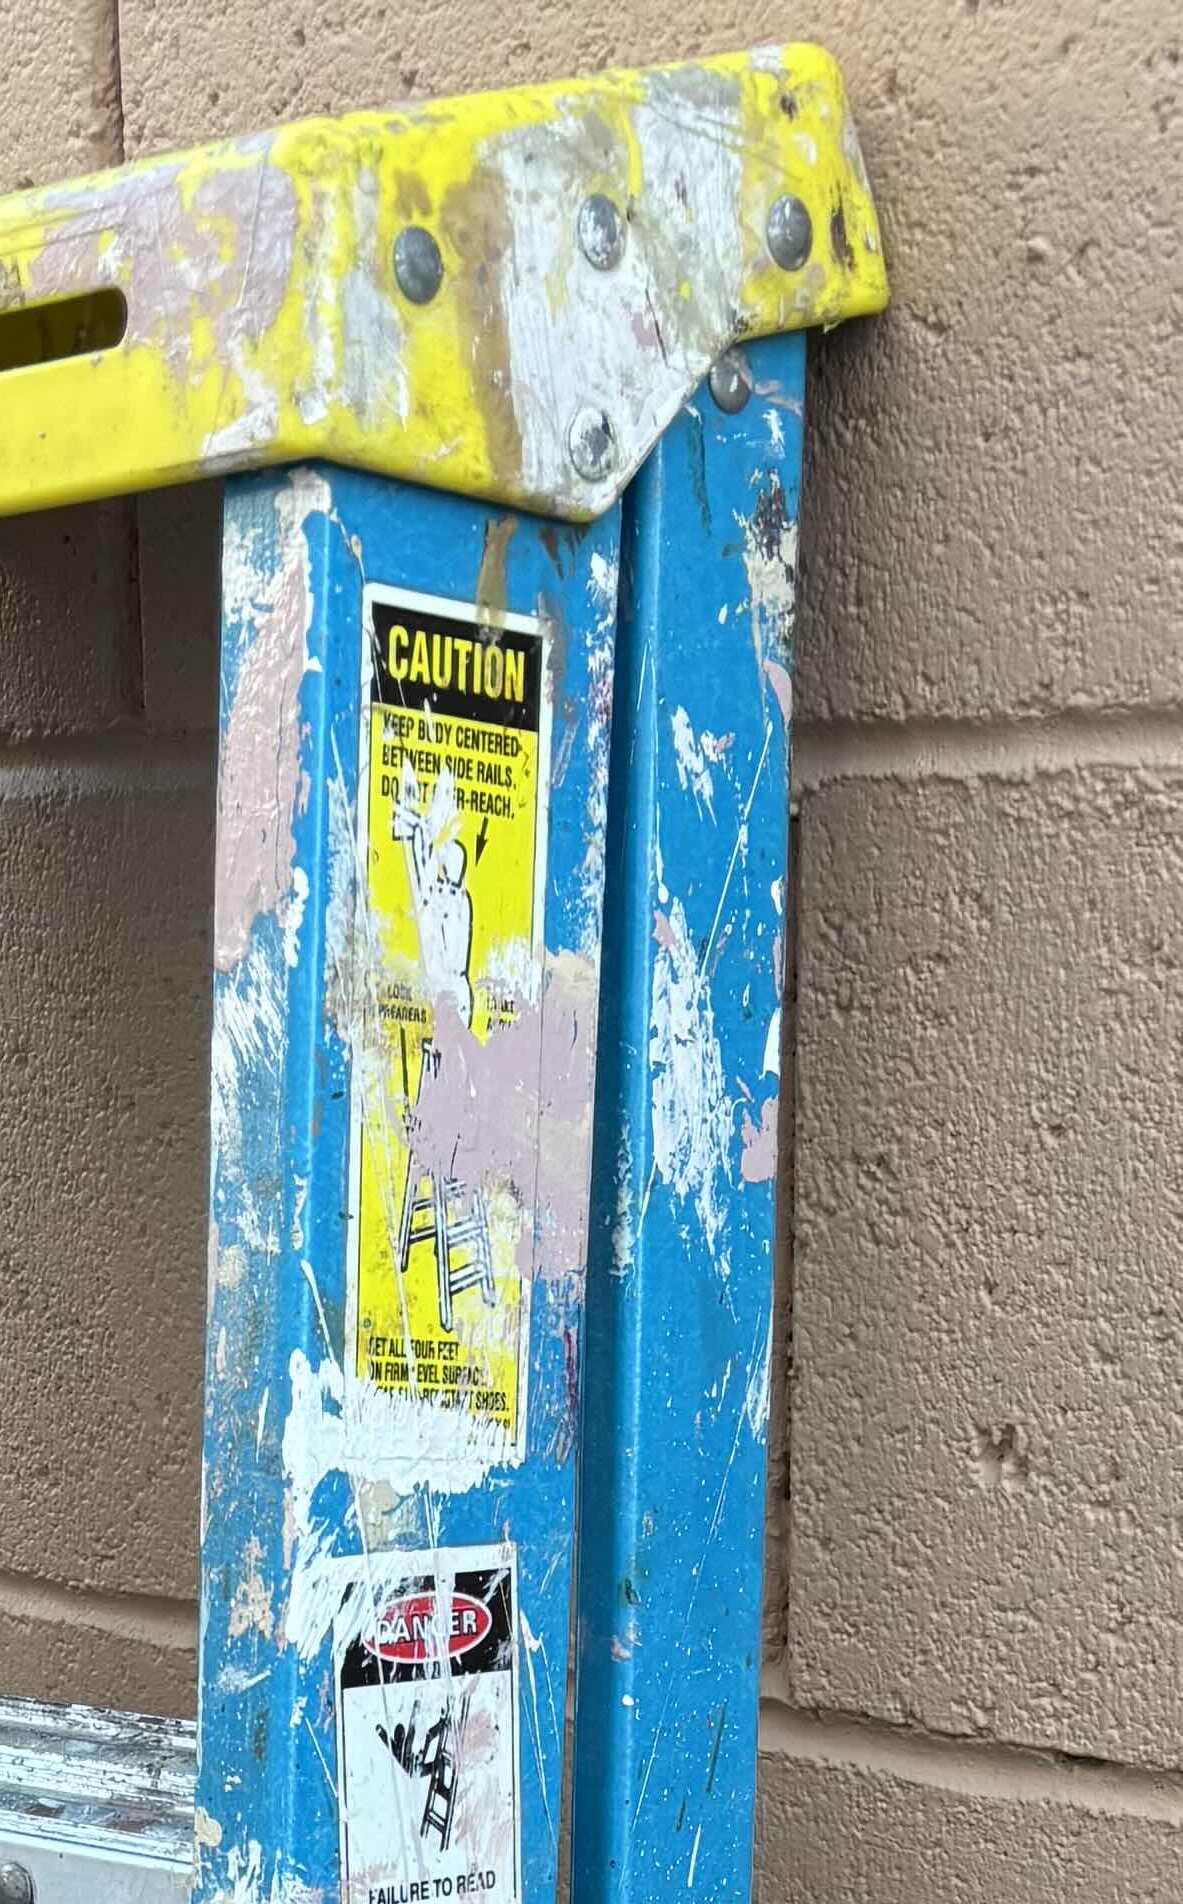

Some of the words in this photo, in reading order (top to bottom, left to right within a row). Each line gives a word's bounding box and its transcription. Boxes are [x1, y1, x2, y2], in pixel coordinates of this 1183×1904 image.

[388, 624, 526, 703] CAUTION
[455, 726, 519, 758] CENTERED
[476, 760, 517, 791] RAILS.
[411, 1363, 440, 1384] EVEL
[375, 1608, 478, 1646] DANER
[432, 1877, 453, 1902] TO
[456, 1870, 497, 1895] READ
